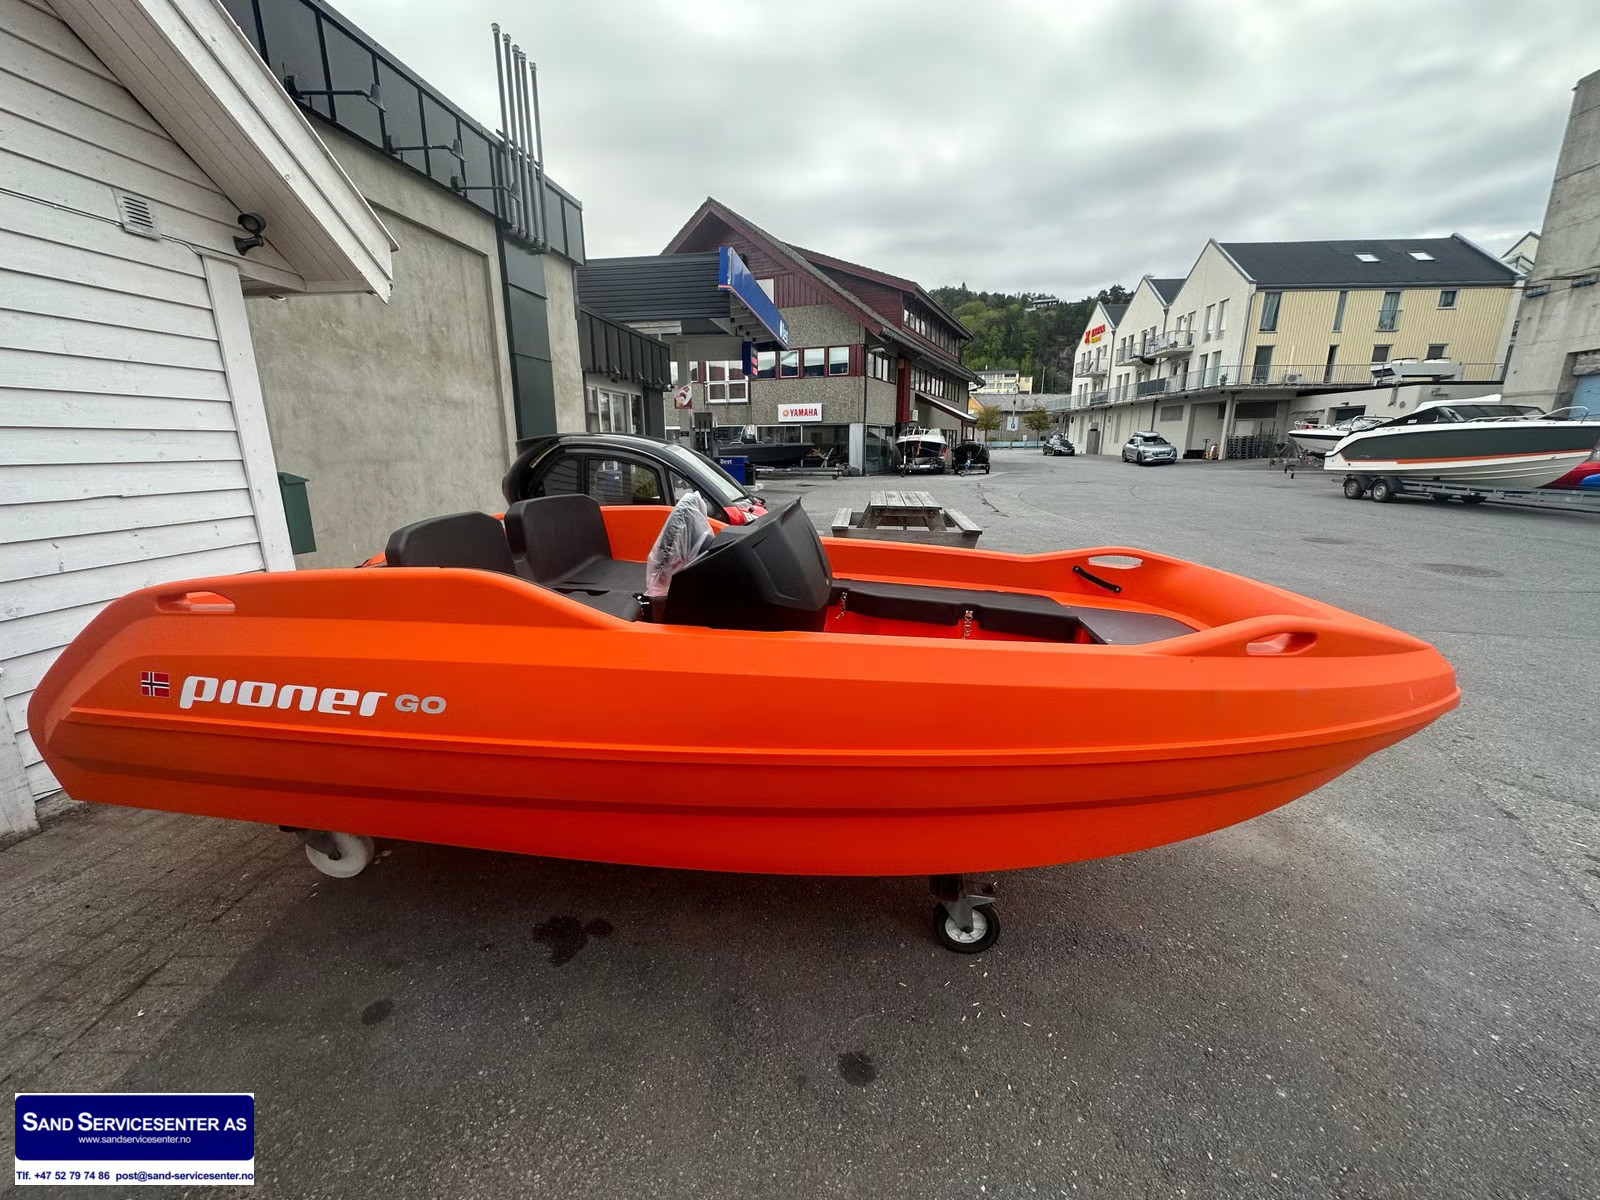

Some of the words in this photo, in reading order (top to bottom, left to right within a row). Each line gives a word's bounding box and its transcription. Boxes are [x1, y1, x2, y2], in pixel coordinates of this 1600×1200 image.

[790, 408, 818, 417] YAMAHA
[179, 675, 388, 717] pioner
[394, 694, 447, 714] GO
